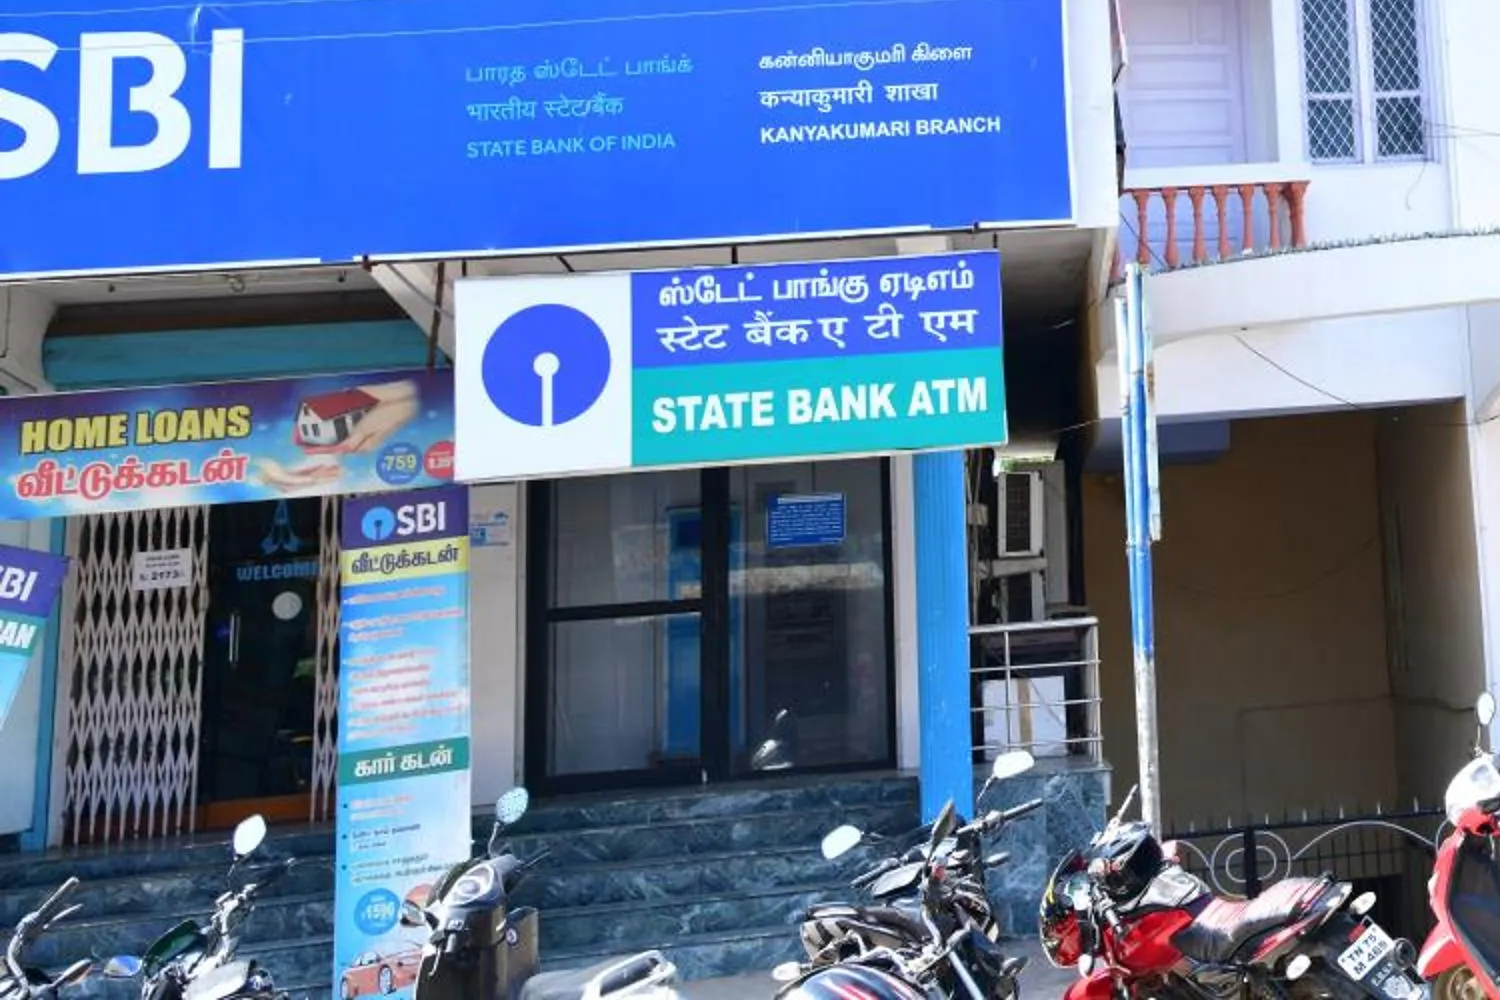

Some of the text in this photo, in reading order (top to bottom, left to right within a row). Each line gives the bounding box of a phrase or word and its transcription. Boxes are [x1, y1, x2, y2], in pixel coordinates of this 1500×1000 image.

[465, 65, 527, 87] பாரத
[533, 55, 619, 79] ஸ்டேட்
[758, 41, 973, 71] கன்னியாகுமரி கிளை
[465, 95, 538, 121] भारतीय
[758, 79, 940, 113] कन्याकुमारी शाखा
[466, 132, 676, 159] STATE BANK OF INDIA
[760, 116, 1001, 144] KANYAKUMARI BRANCH
[659, 260, 974, 307] ஸ்டேட் பாங்கு ஏடிஎம்
[655, 303, 979, 353] स्टेट बैंक ए टी एम
[652, 377, 987, 433] STATE BANK ATM
[20, 405, 251, 455] HOME LOANS
[15, 448, 249, 500] வீட்டுக்கடன்
[396, 501, 446, 536] SBI
[351, 543, 460, 575] வீட்டுக்கடன்
[0, 565, 39, 601] BI
[354, 744, 454, 777] கார் கடன்
